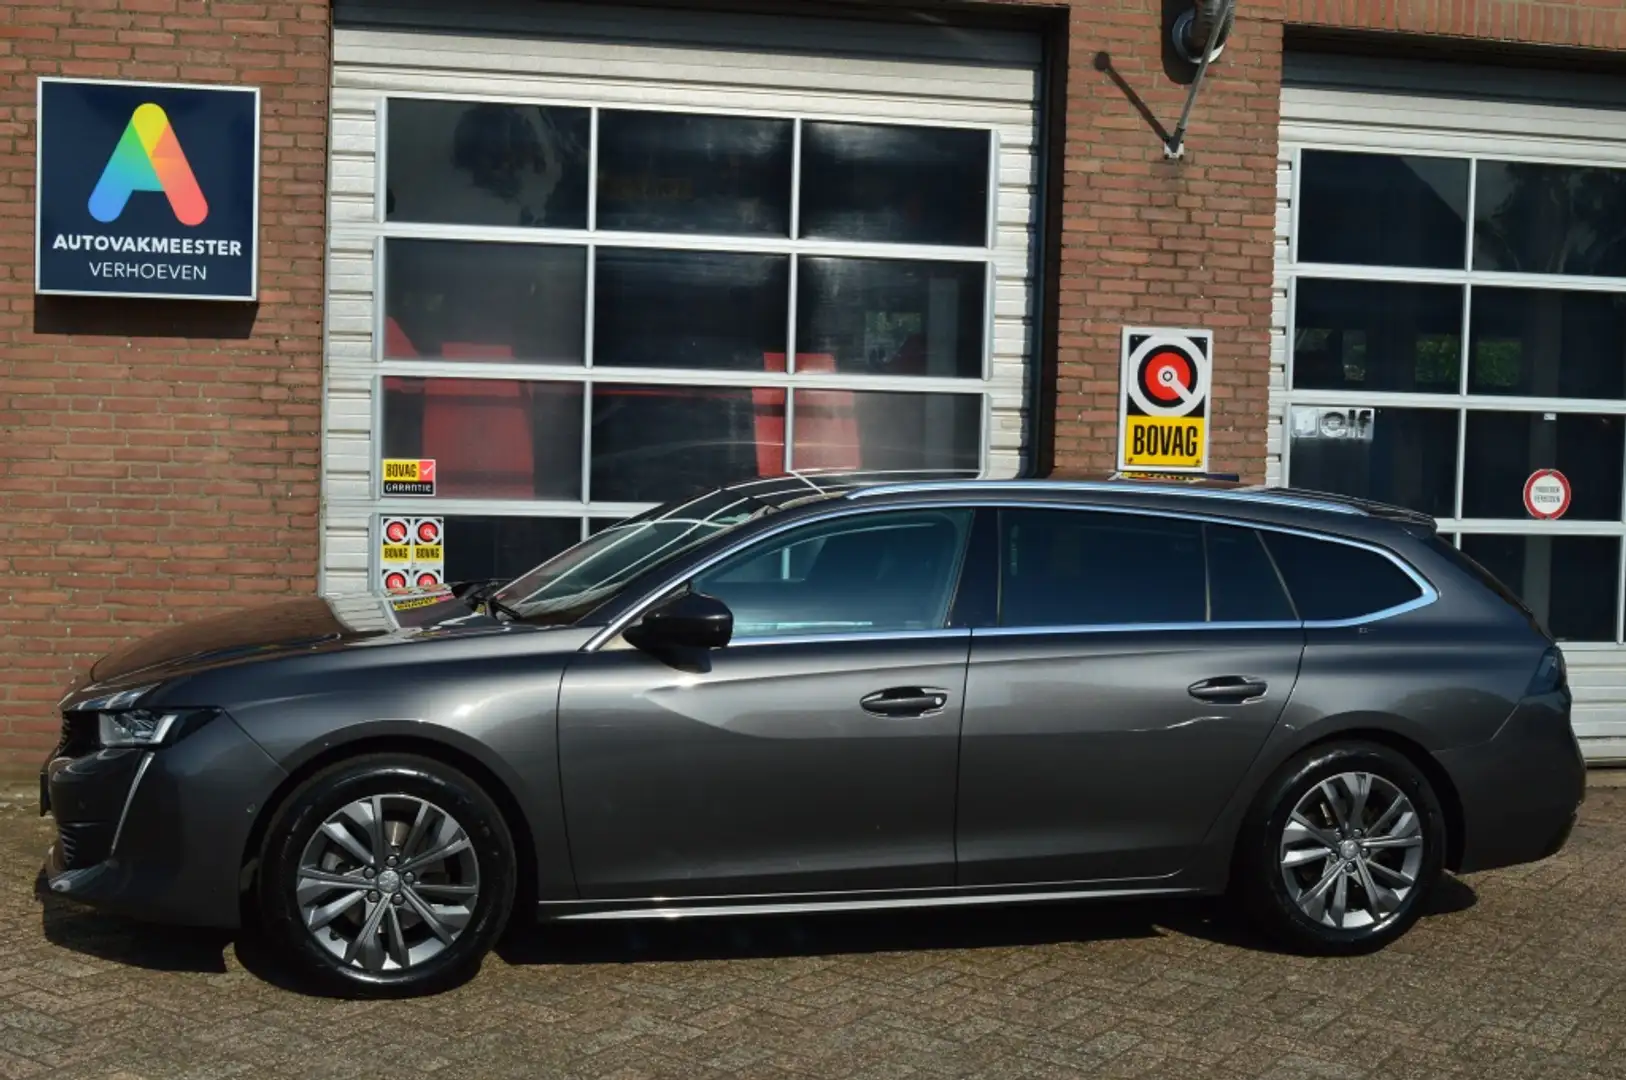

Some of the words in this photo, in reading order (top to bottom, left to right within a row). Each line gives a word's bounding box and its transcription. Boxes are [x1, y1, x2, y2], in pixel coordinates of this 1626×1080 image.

[53, 234, 242, 256] AUTOVAKMEESTER
[89, 261, 207, 281] VERHOEVEN
[1133, 424, 1198, 457] BOVAG
[386, 463, 417, 478] BOVAG
